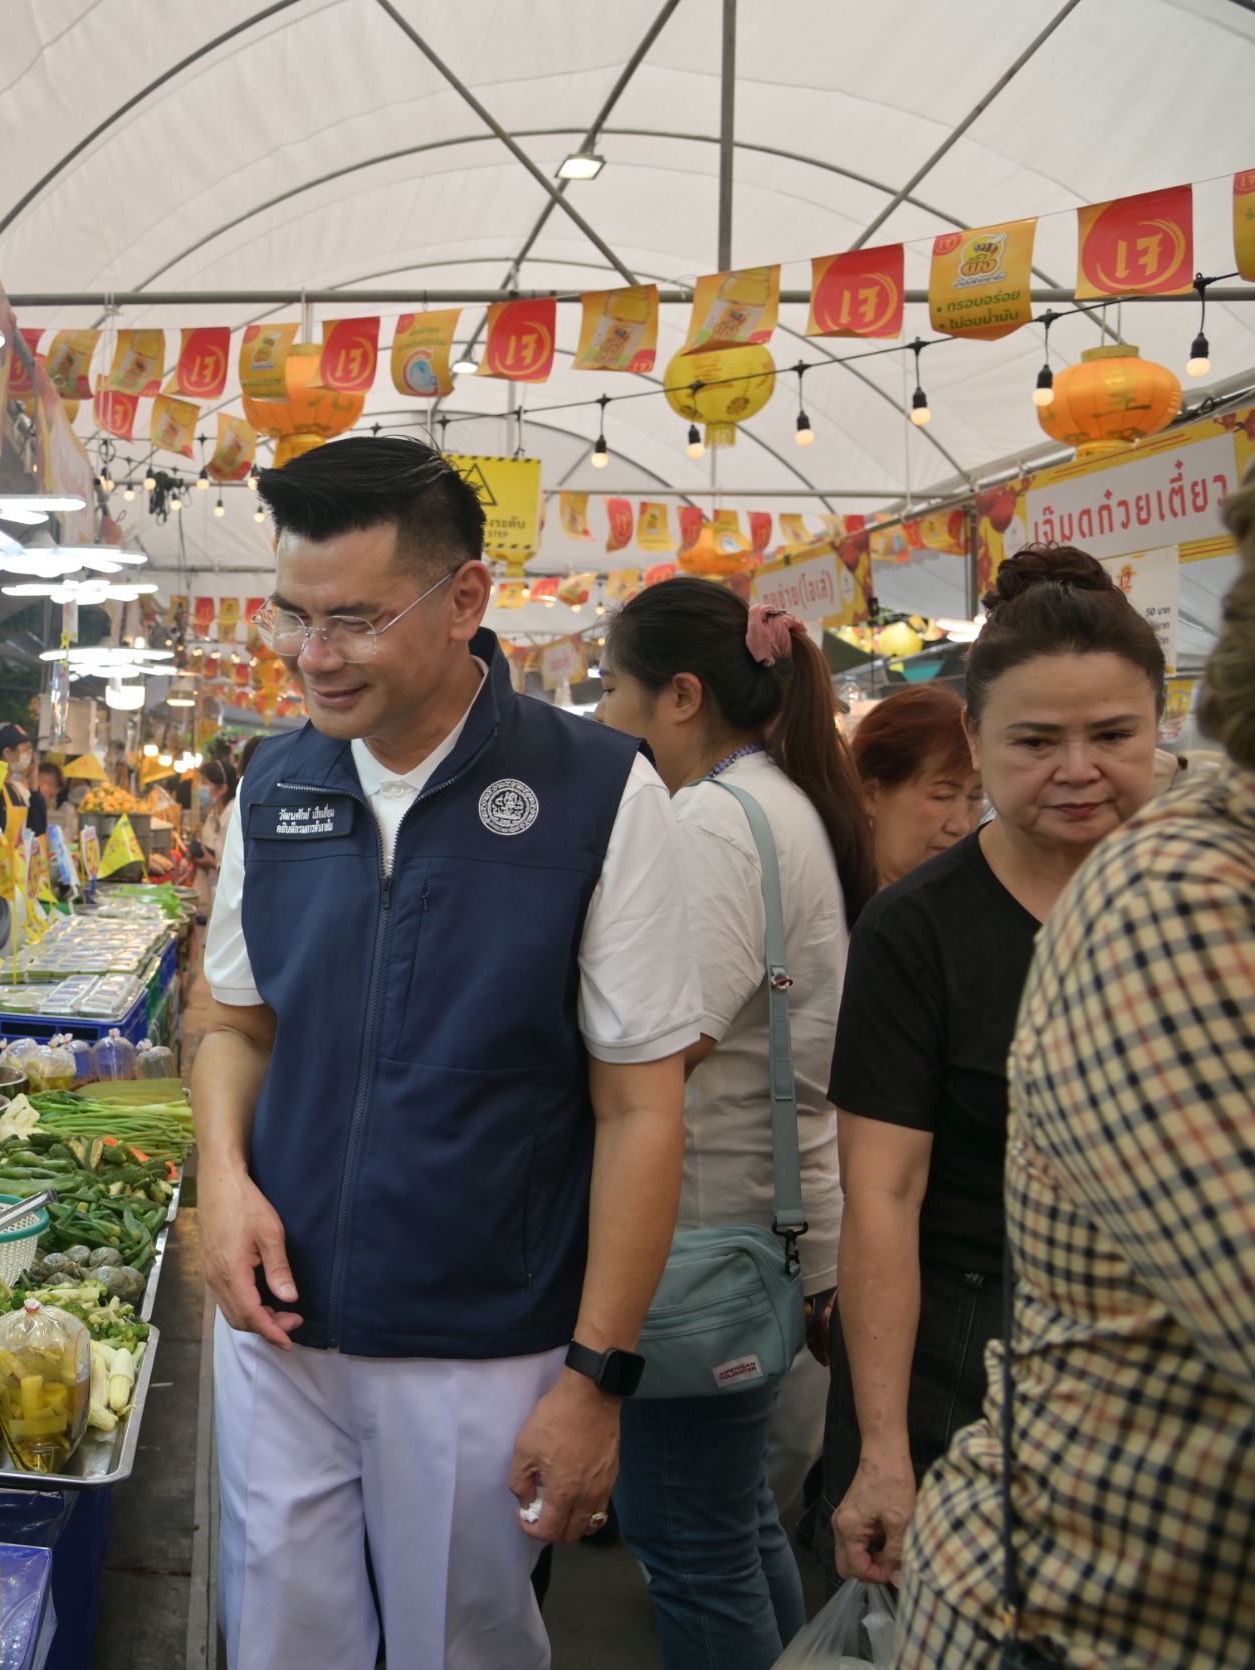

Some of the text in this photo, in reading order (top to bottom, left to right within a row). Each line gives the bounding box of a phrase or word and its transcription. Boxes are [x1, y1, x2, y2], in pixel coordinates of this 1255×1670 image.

[1115, 232, 1163, 280] เจ
[839, 284, 881, 325] เจ
[947, 290, 1021, 312] กรอบอร่อย
[949, 308, 1019, 329] ไม่อมน้ำมัน
[335, 347, 364, 379] เจ
[506, 333, 539, 366] เจ
